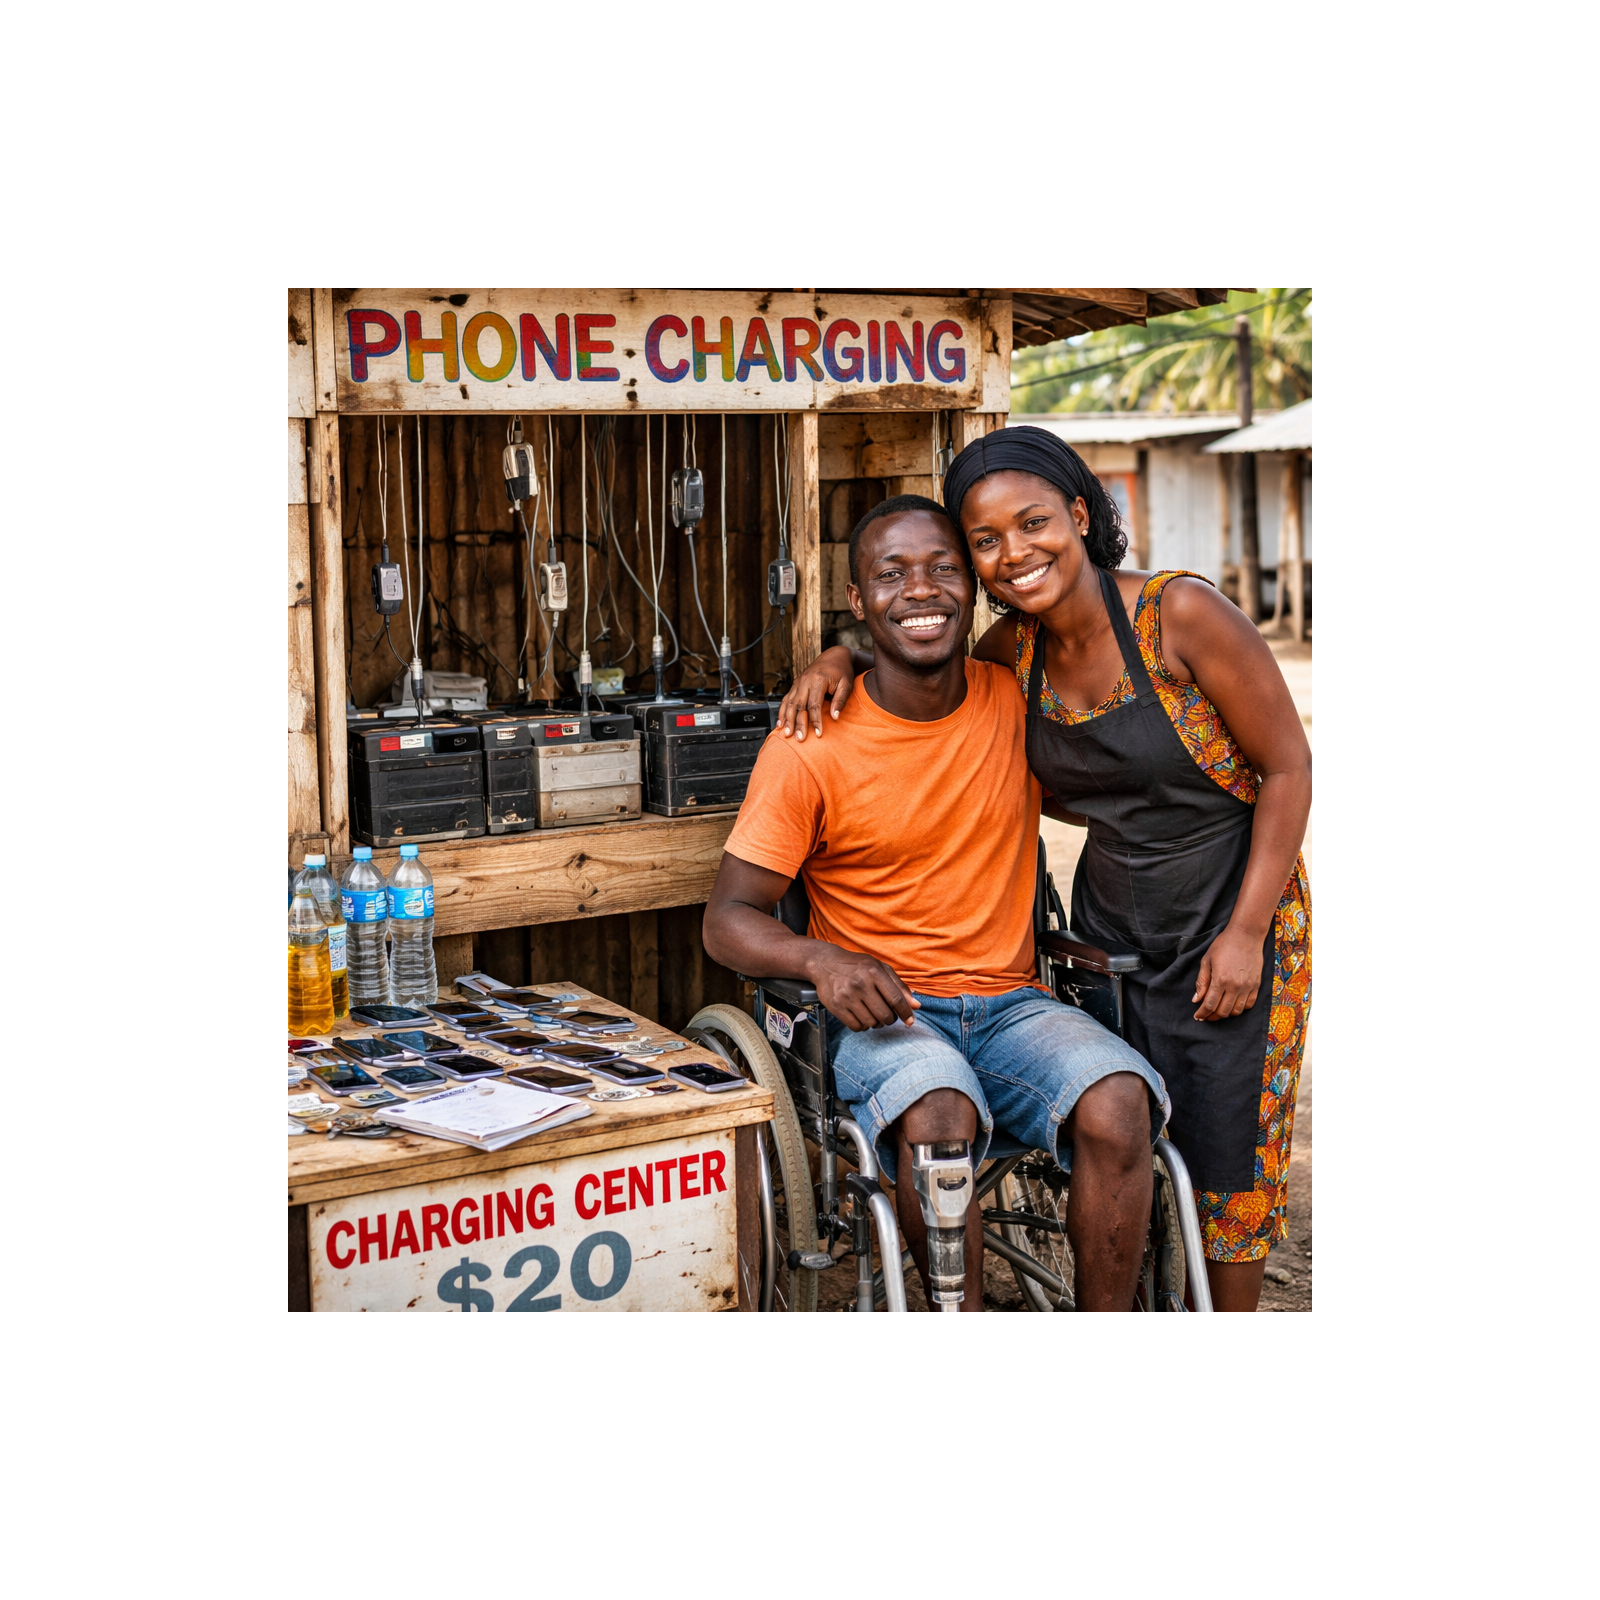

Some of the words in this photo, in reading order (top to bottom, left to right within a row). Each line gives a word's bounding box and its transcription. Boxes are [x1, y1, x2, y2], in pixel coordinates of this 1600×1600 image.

[347, 308, 620, 383] PHONE
[645, 314, 966, 383] CHARGING
[326, 1183, 555, 1269] CHARGING
[574, 1150, 727, 1221] CENTER
[437, 1231, 632, 1312] $20
